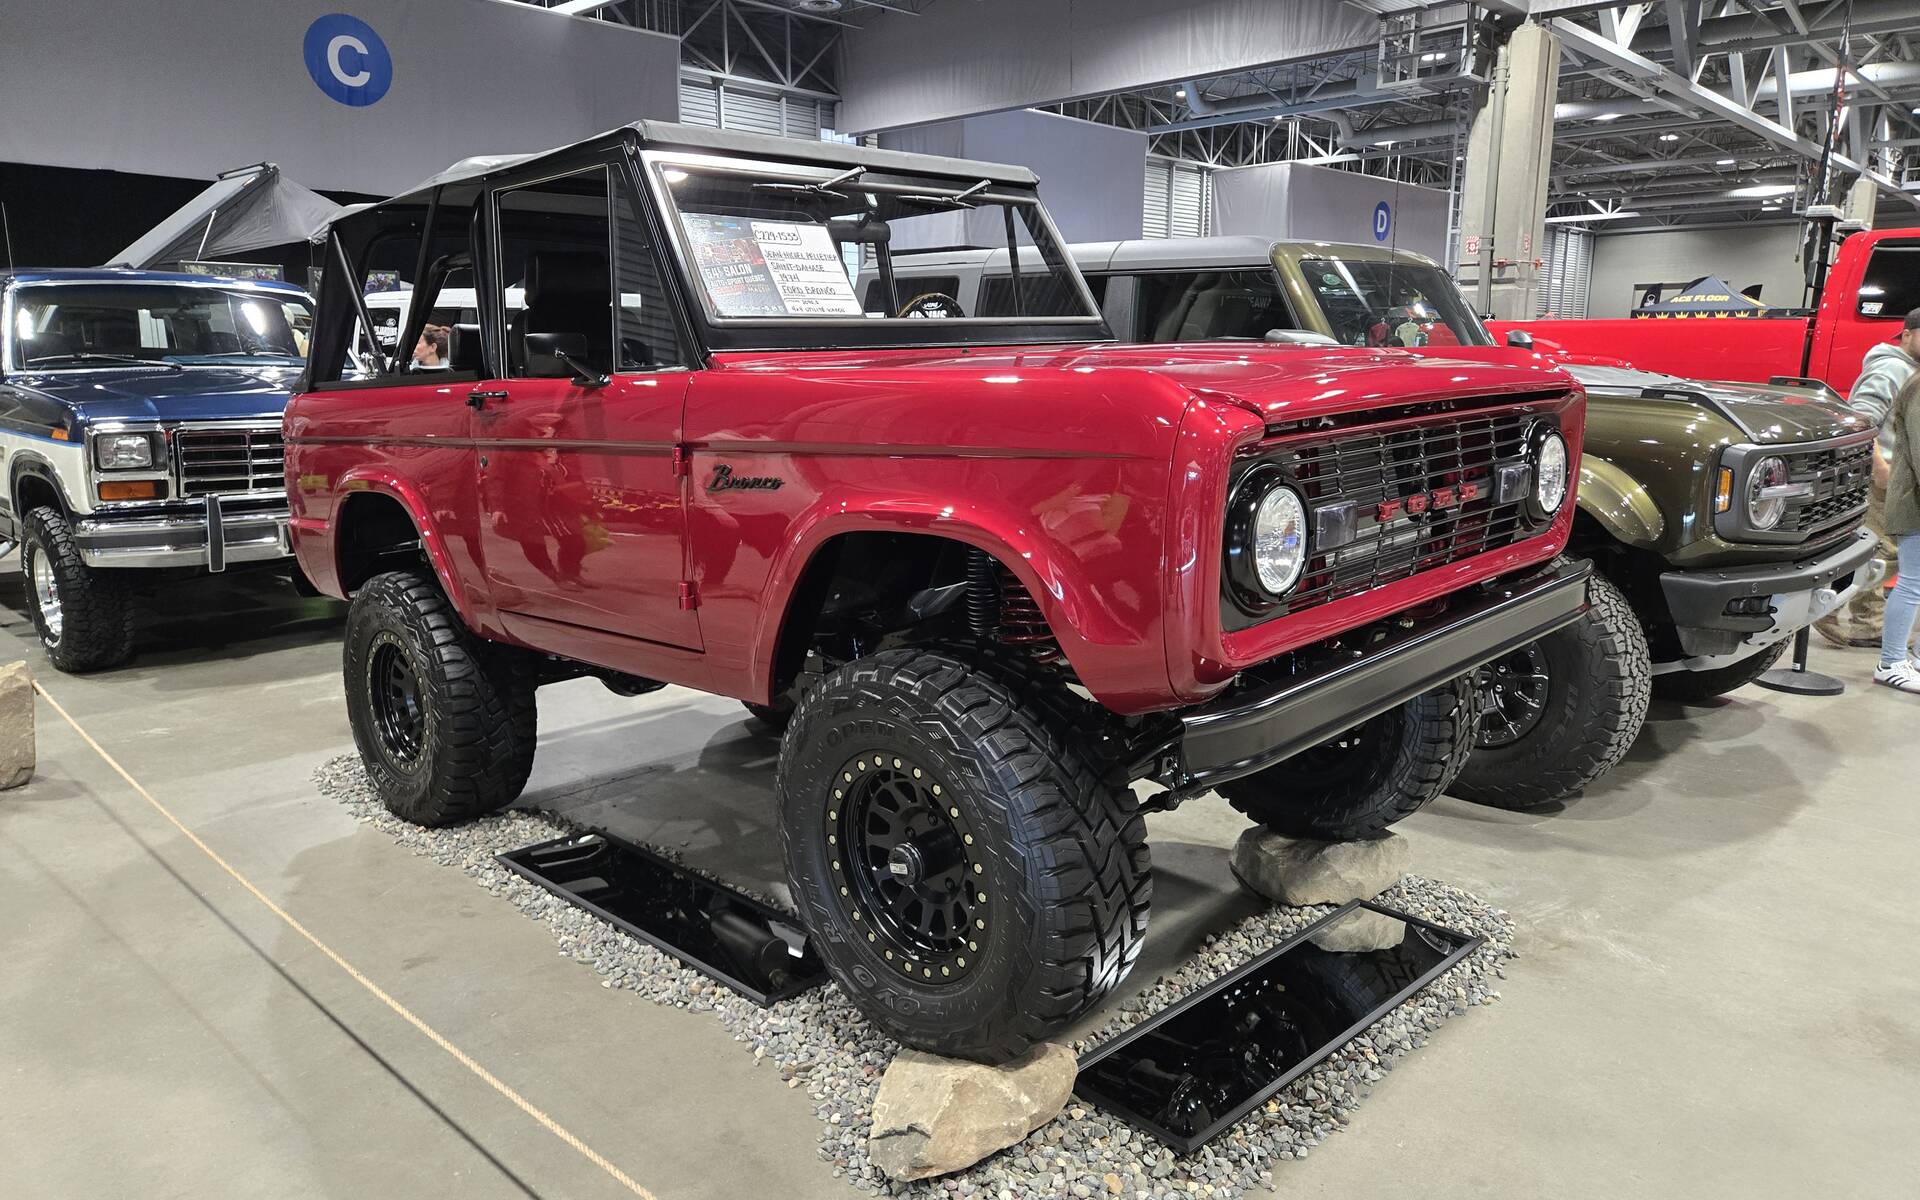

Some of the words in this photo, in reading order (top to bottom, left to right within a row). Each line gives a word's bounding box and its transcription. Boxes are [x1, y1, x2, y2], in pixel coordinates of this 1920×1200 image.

[327, 35, 370, 87] C
[1377, 209, 1388, 232] D
[722, 263, 753, 277] SALON
[770, 262, 824, 272] SAINT-DAMASE
[779, 273, 800, 282] 1974
[781, 285, 804, 295] FORD
[805, 286, 836, 296] BRONCO
[1694, 294, 1730, 303] FLOOR
[707, 463, 786, 495] Bronco
[1377, 481, 1479, 522] FORD
